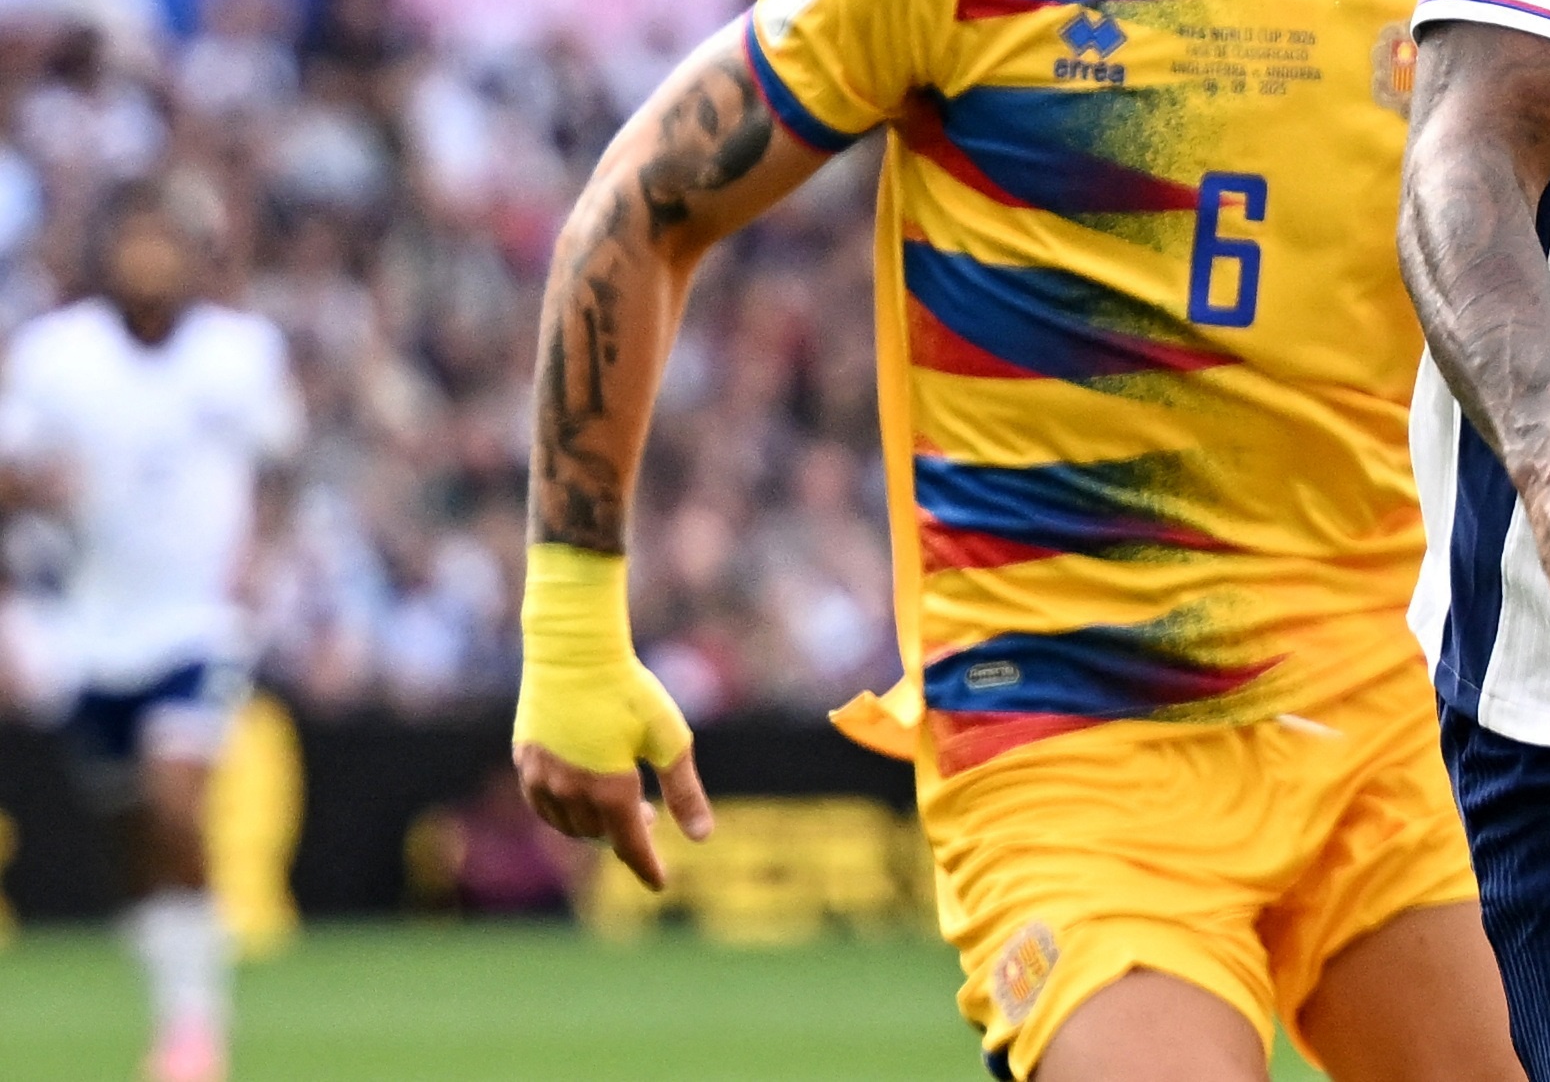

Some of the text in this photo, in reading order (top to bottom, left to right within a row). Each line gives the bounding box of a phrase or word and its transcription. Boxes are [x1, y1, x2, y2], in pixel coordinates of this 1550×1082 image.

[1210, 26, 1252, 42] WORLD
[1258, 27, 1282, 44] CUP
[1265, 65, 1322, 80] ANDORRA
[1187, 171, 1268, 328] 6
